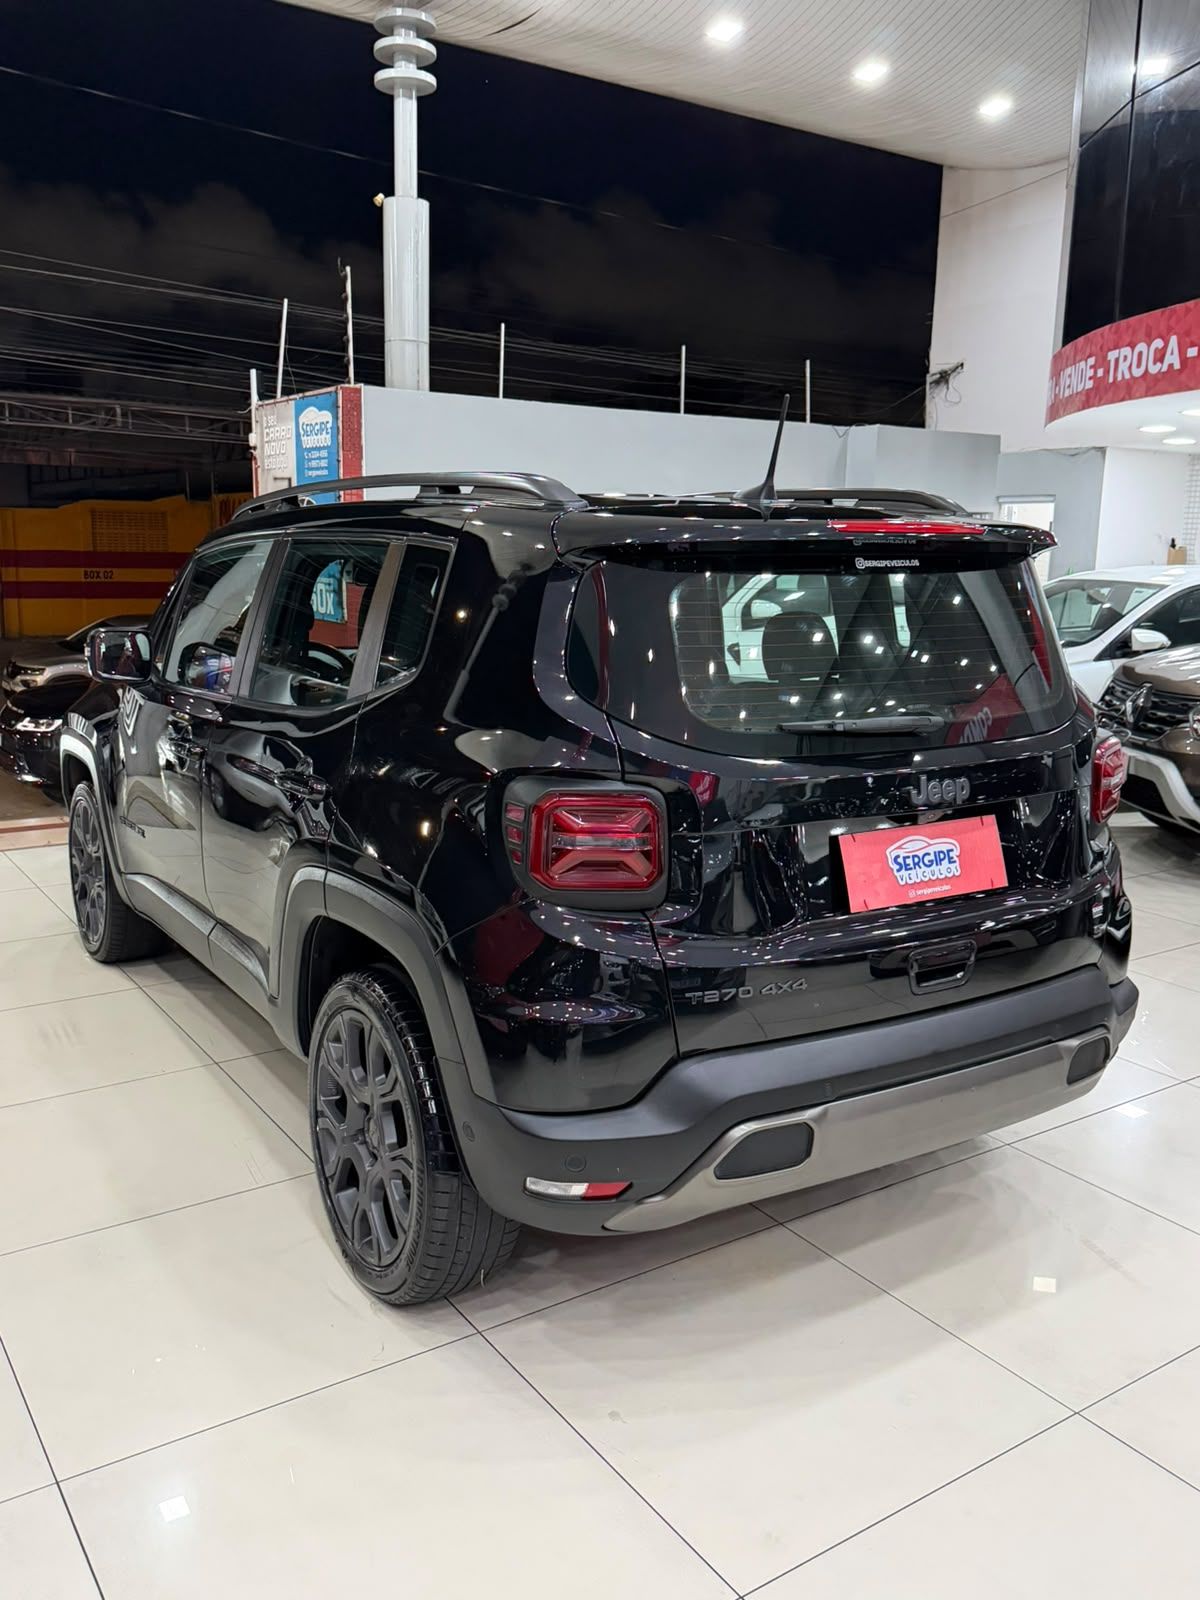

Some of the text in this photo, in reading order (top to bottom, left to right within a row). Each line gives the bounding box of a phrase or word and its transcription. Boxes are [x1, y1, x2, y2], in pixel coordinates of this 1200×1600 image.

[1060, 356, 1095, 399] VENDE
[1107, 335, 1181, 383] TROCA
[264, 426, 292, 442] CARRO
[301, 421, 331, 437] SERGIPE
[264, 441, 286, 457] NOVO
[83, 570, 114, 580] BOX 02
[909, 774, 971, 806] Jeep
[893, 848, 957, 873] SERGIPE
[685, 986, 754, 1005] T270
